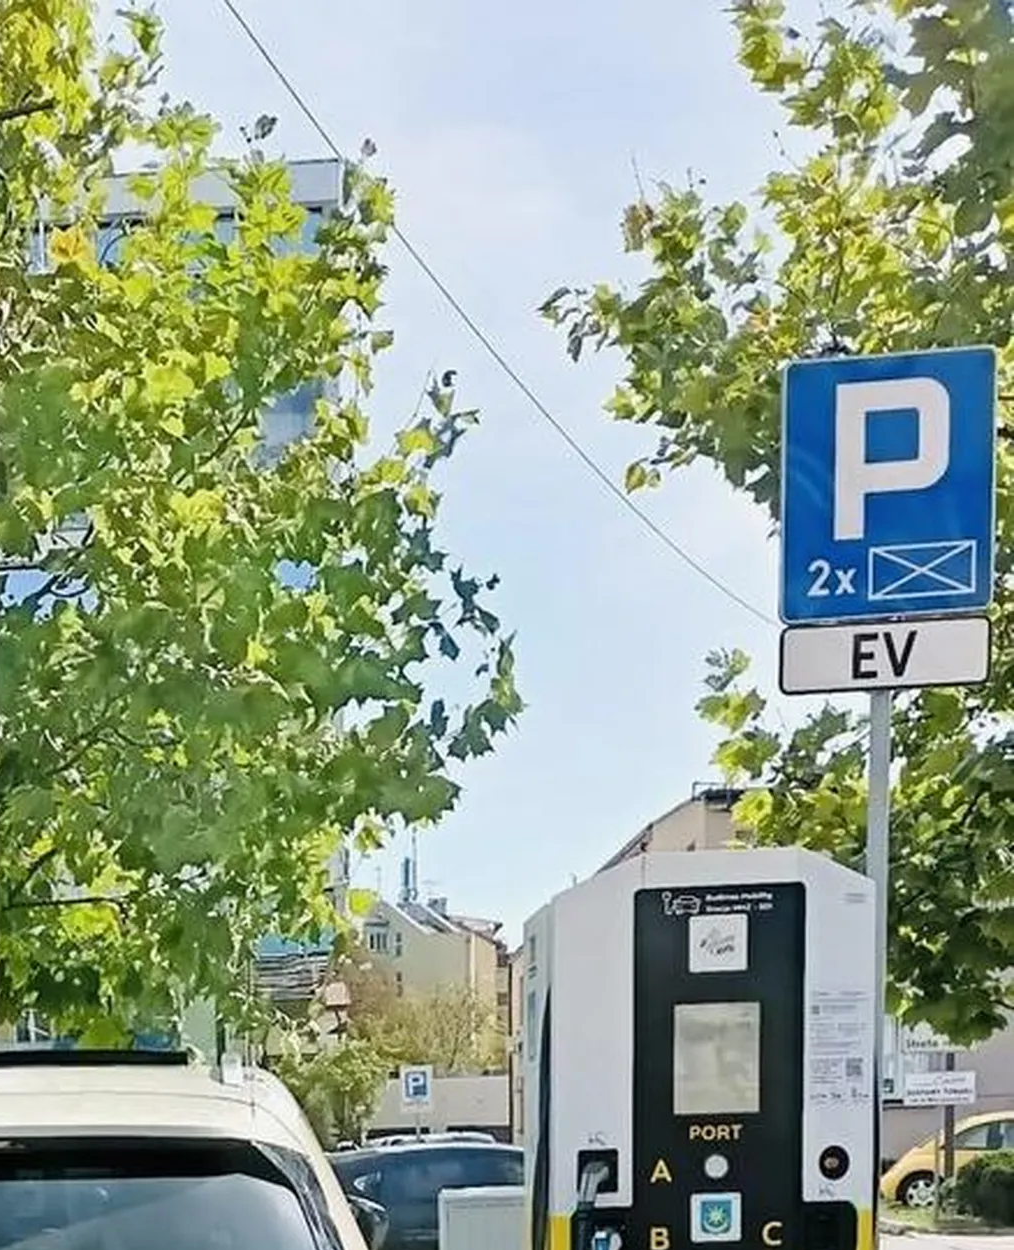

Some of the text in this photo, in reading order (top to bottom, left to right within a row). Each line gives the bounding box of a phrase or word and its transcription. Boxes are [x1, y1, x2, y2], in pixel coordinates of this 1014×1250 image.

[833, 376, 951, 541] P
[806, 558, 856, 597] 2x
[851, 629, 918, 680] EV
[689, 1124, 743, 1140] PORT
[649, 1158, 673, 1183] A
[649, 1226, 671, 1250] B
[761, 1220, 783, 1247] C
